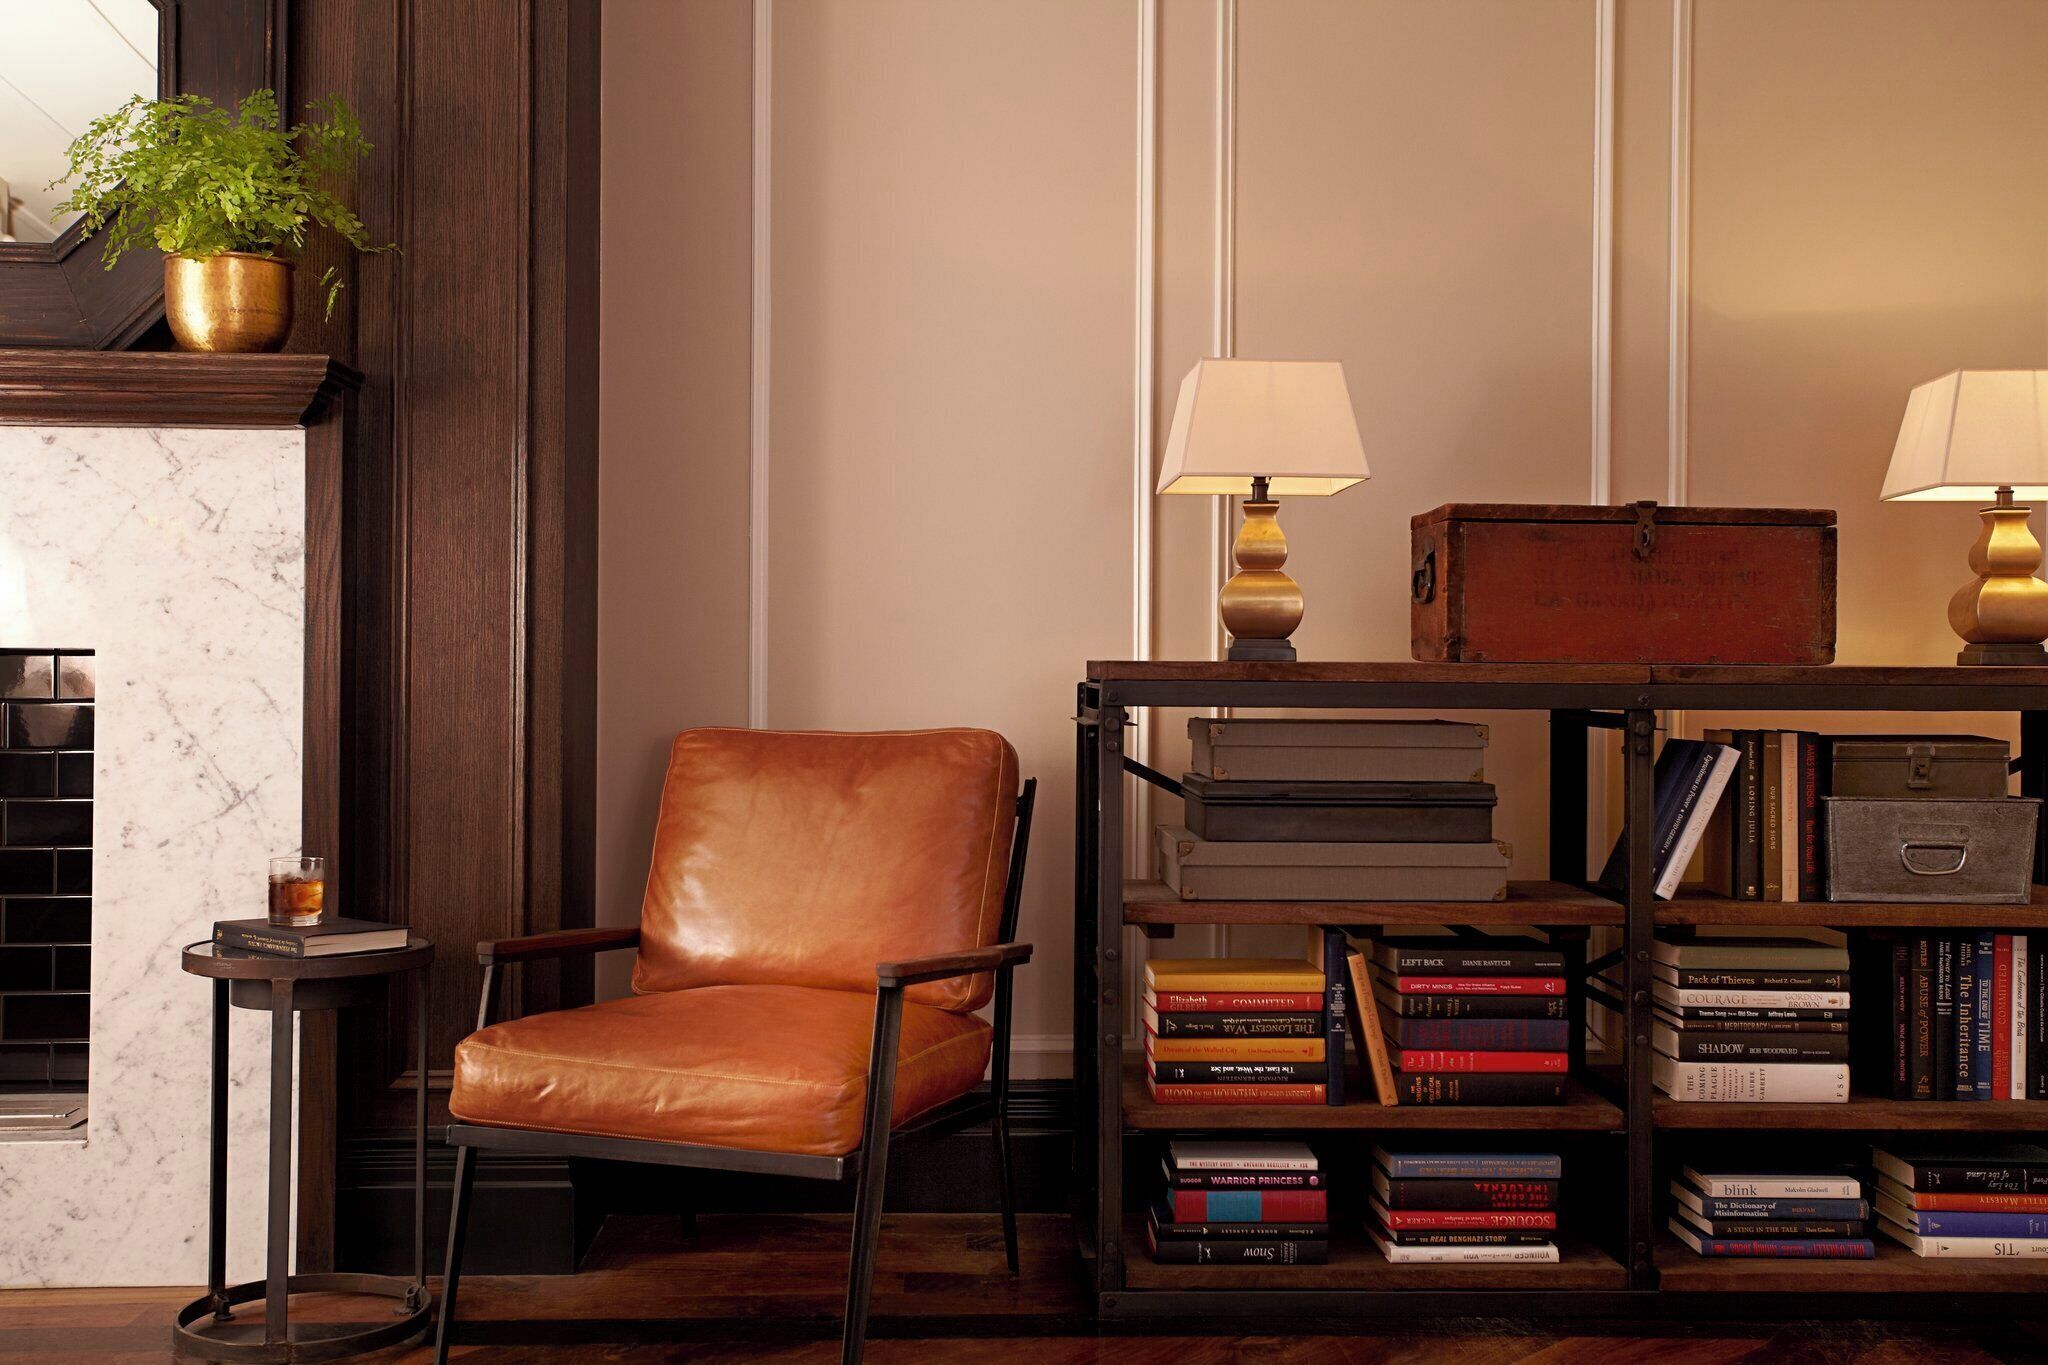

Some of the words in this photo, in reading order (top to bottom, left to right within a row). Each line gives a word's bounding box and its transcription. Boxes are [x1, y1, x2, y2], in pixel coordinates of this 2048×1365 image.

[1807, 744, 1815, 766] JAMES
[1694, 753, 1713, 786] Eyewitness
[1807, 768, 1815, 808] PATTERSON
[1683, 790, 1696, 809] Power
[1672, 813, 1684, 830] DAVID
[1748, 820, 1756, 843] JULIA
[1806, 845, 1814, 860] Your
[2017, 957, 2025, 968] The
[1688, 976, 1709, 984] Pack
[1711, 976, 1720, 984] of
[1721, 976, 1755, 985] Thieves
[1981, 979, 1989, 987] TO
[2017, 970, 2026, 1000] Conference
[1920, 975, 1928, 1008] ABUSE
[1959, 975, 1972, 998] The
[1170, 995, 1207, 1003] Elizabeth
[1687, 994, 1747, 1004] COURAGE
[1981, 989, 1989, 999] THE
[1233, 999, 1294, 1008] COMMITTED
[1981, 1000, 1989, 1011] END
[1918, 1009, 1928, 1019] of
[2017, 1011, 2025, 1020] the
[1223, 1024, 1248, 1034] WAR
[1250, 1024, 1292, 1034] LONGEST
[1294, 1024, 1315, 1034] THE
[1725, 1022, 1767, 1030] MERITOCRACY
[2016, 1022, 2025, 1037] Birds
[1920, 1020, 1928, 1057] POWER
[1959, 1003, 1972, 1078] Inheritance
[1978, 1021, 1990, 1052] TIME
[1698, 1044, 1744, 1054] SHADOW
[1966, 1171, 1986, 1180] Land
[1989, 1171, 2000, 1179] the
[2002, 1170, 2009, 1180] of
[1211, 1176, 1257, 1185] WARRIOR
[1258, 1176, 1303, 1185] PRINCESS
[1988, 1180, 2002, 1190] Lay
[1473, 1183, 1547, 1192] INFLUENZA
[1724, 1185, 1758, 1196] blink
[2004, 1182, 2019, 1190] The
[1730, 1202, 1767, 1211] Dictionary
[1491, 1215, 1550, 1227] SCOURGE
[1244, 1247, 1274, 1260] Snow
[1994, 1243, 2020, 1255] 'TIS
